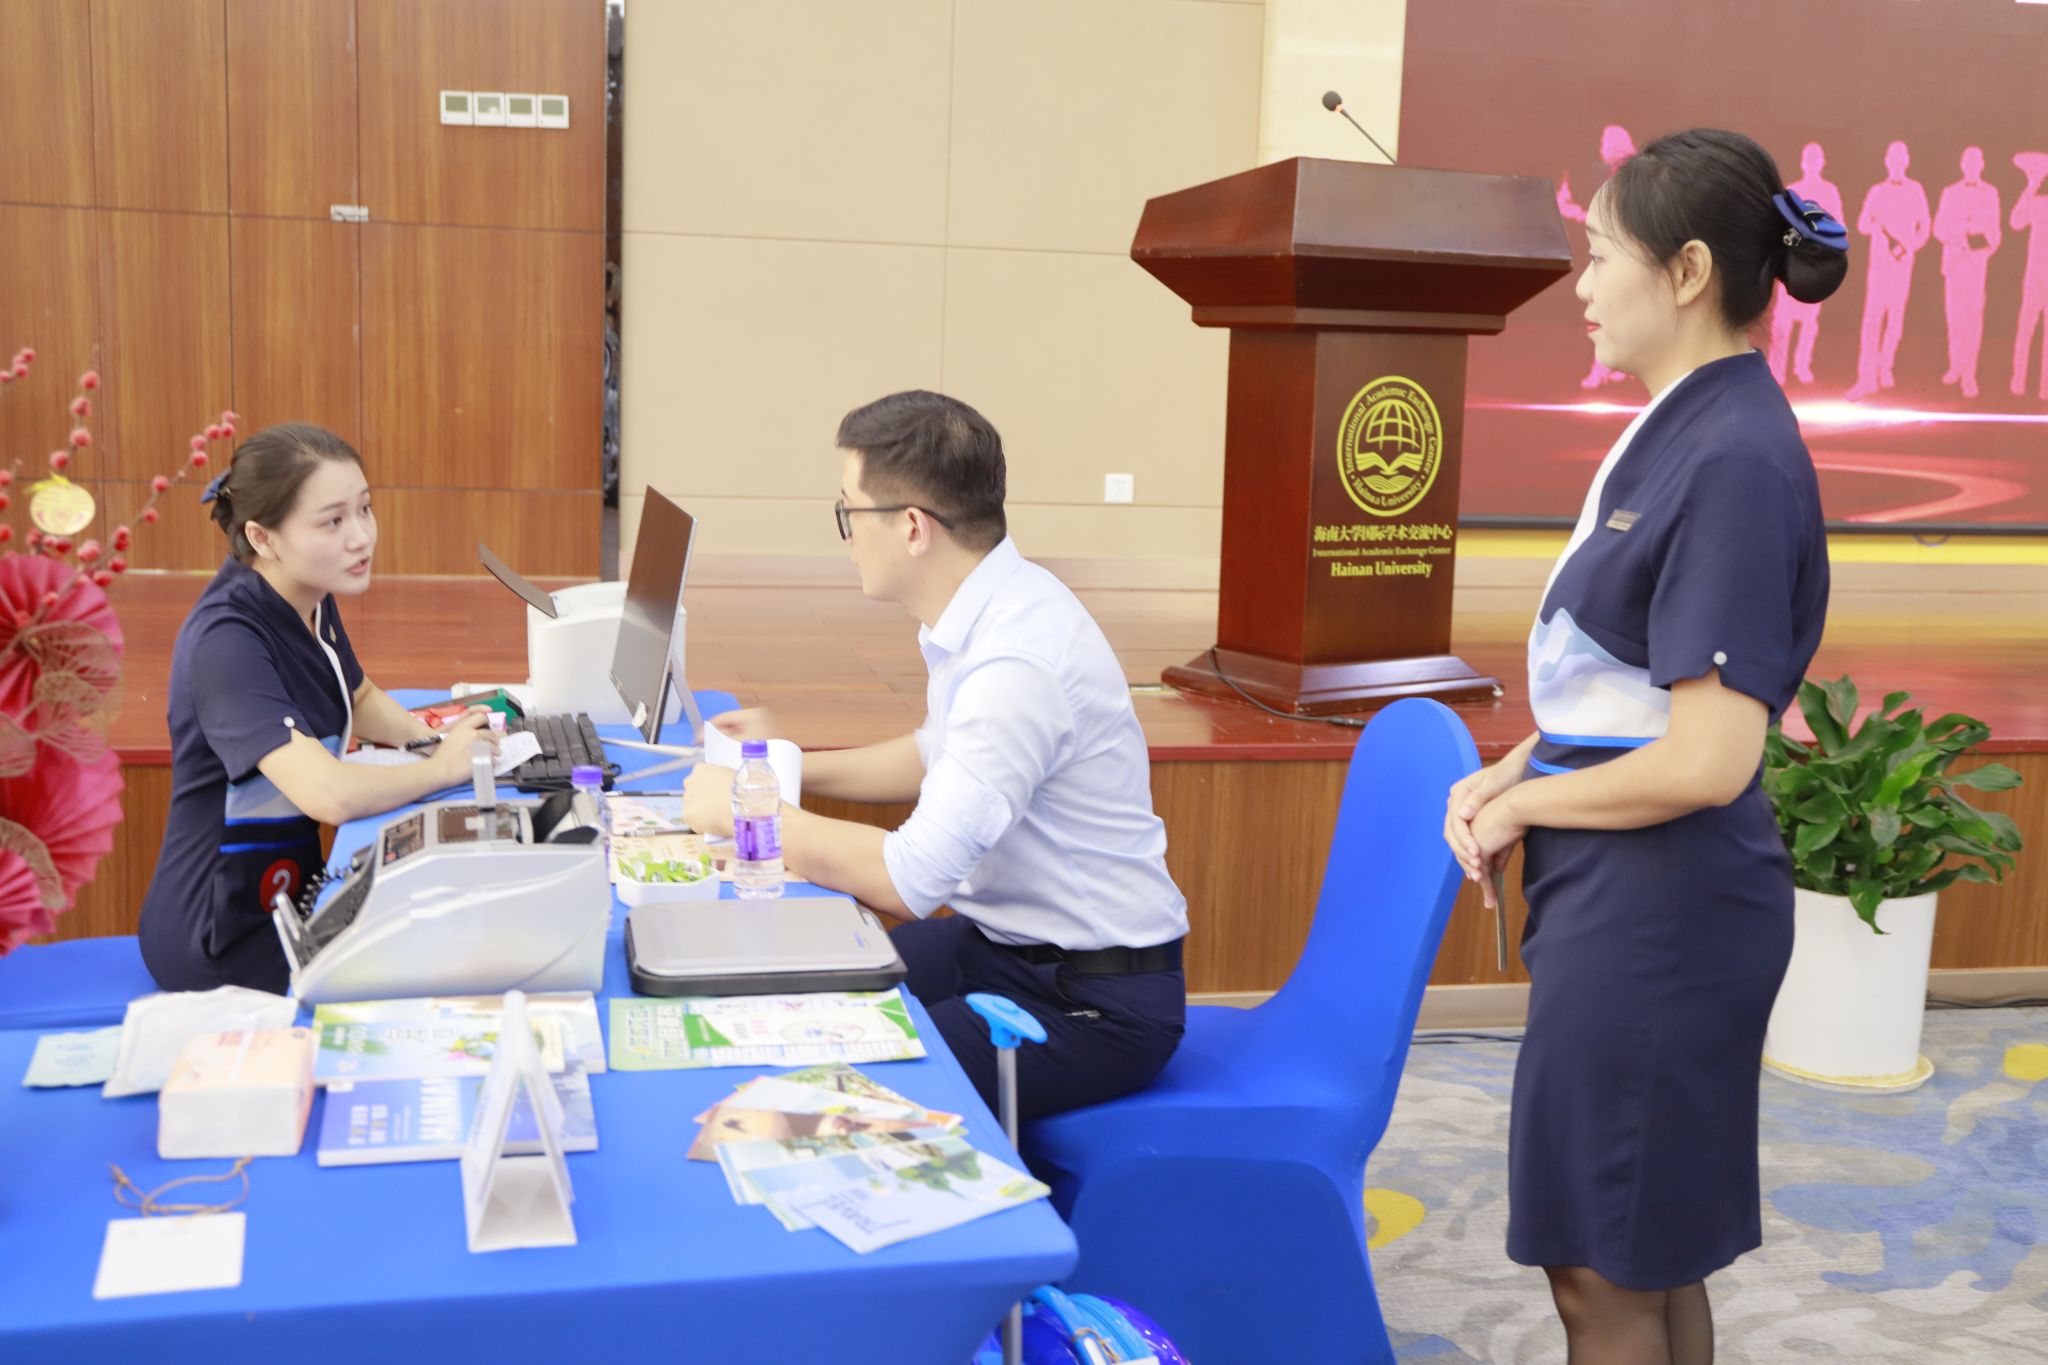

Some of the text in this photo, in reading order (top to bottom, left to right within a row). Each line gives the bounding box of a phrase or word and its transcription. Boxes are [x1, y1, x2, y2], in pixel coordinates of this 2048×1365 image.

[1345, 402, 1366, 475] International
[1366, 386, 1407, 406] Academic
[1425, 436, 1437, 475] Center
[1381, 479, 1422, 507] University
[1313, 523, 1453, 542] 海南大学国际学术交流中心
[1312, 547, 1360, 557] International
[1331, 560, 1432, 578] Hainan University
